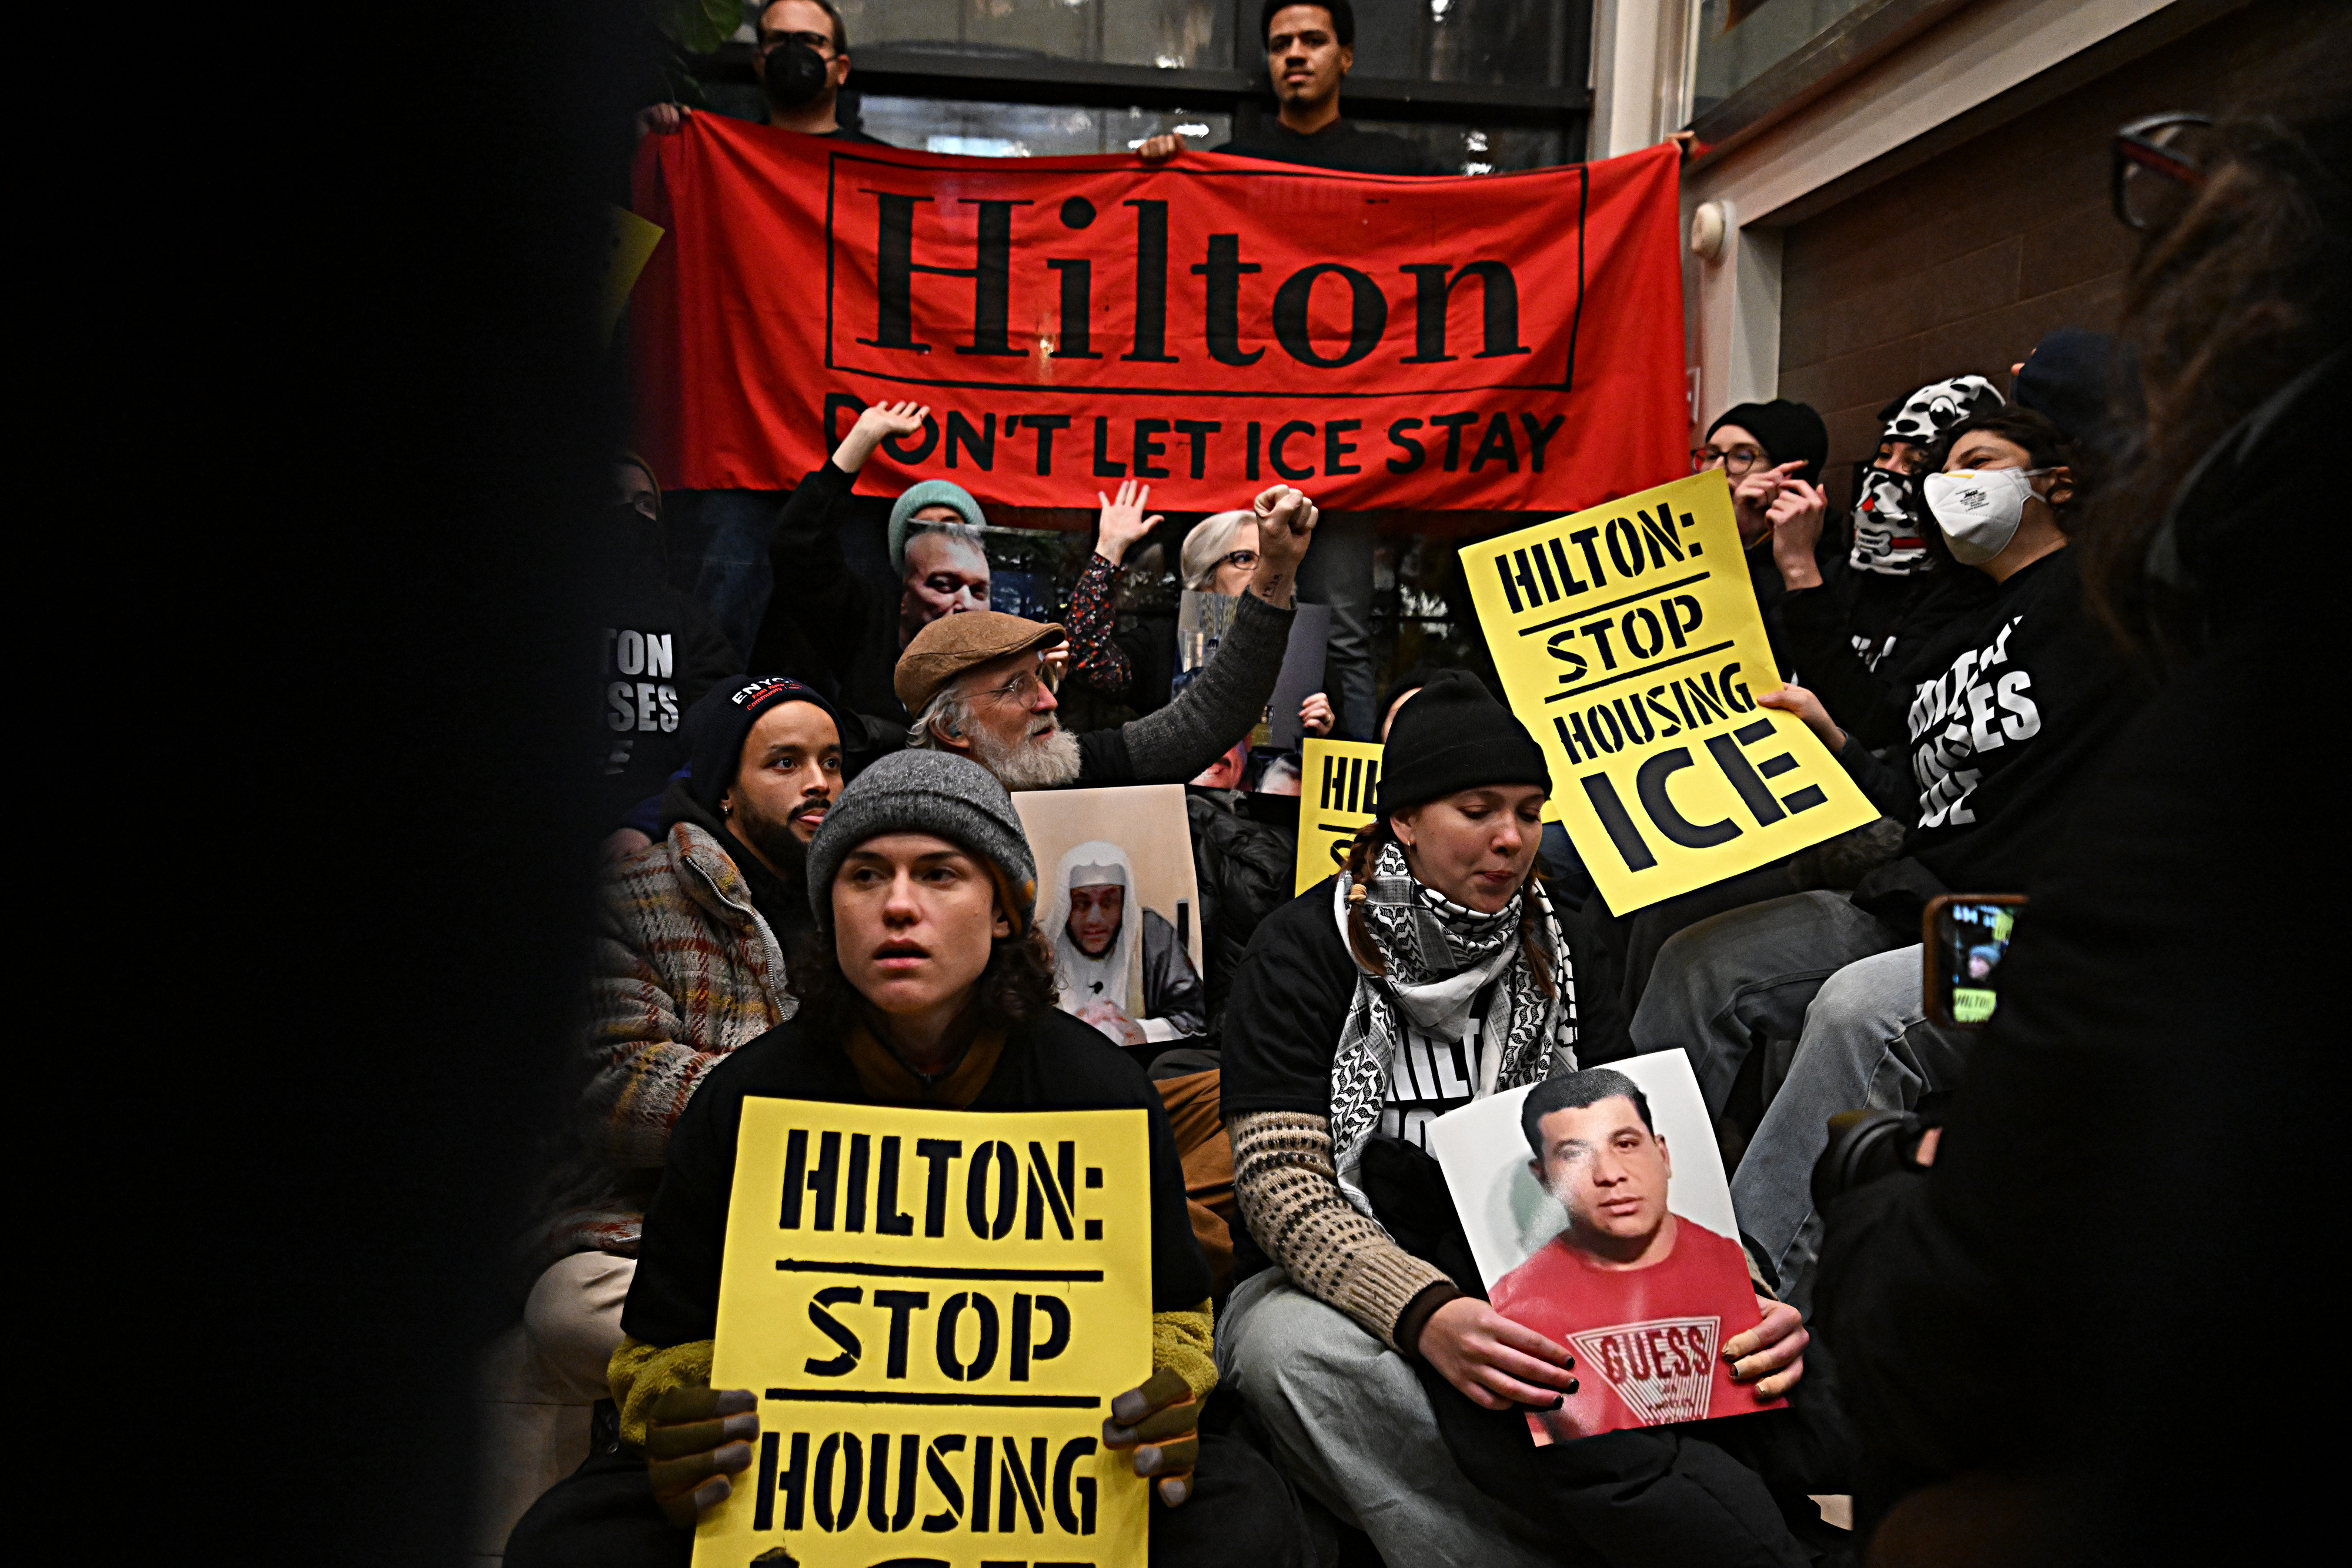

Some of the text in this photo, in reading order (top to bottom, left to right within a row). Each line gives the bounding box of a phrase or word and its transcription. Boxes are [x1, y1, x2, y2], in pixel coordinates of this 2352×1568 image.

[856, 188, 1531, 368] Hilton
[824, 393, 1565, 480] DON'T LET ICE STAY
[1494, 503, 1703, 614] HILTON:
[1546, 594, 1703, 684] STOP
[1553, 662, 1756, 765] HOUSING
[1580, 717, 1828, 873] ICE
[779, 1129, 1103, 1241] HILTON:
[804, 1286, 1071, 1383] STOP
[1601, 1325, 1712, 1384] GUESS
[753, 1431, 1098, 1536] HOUSING
